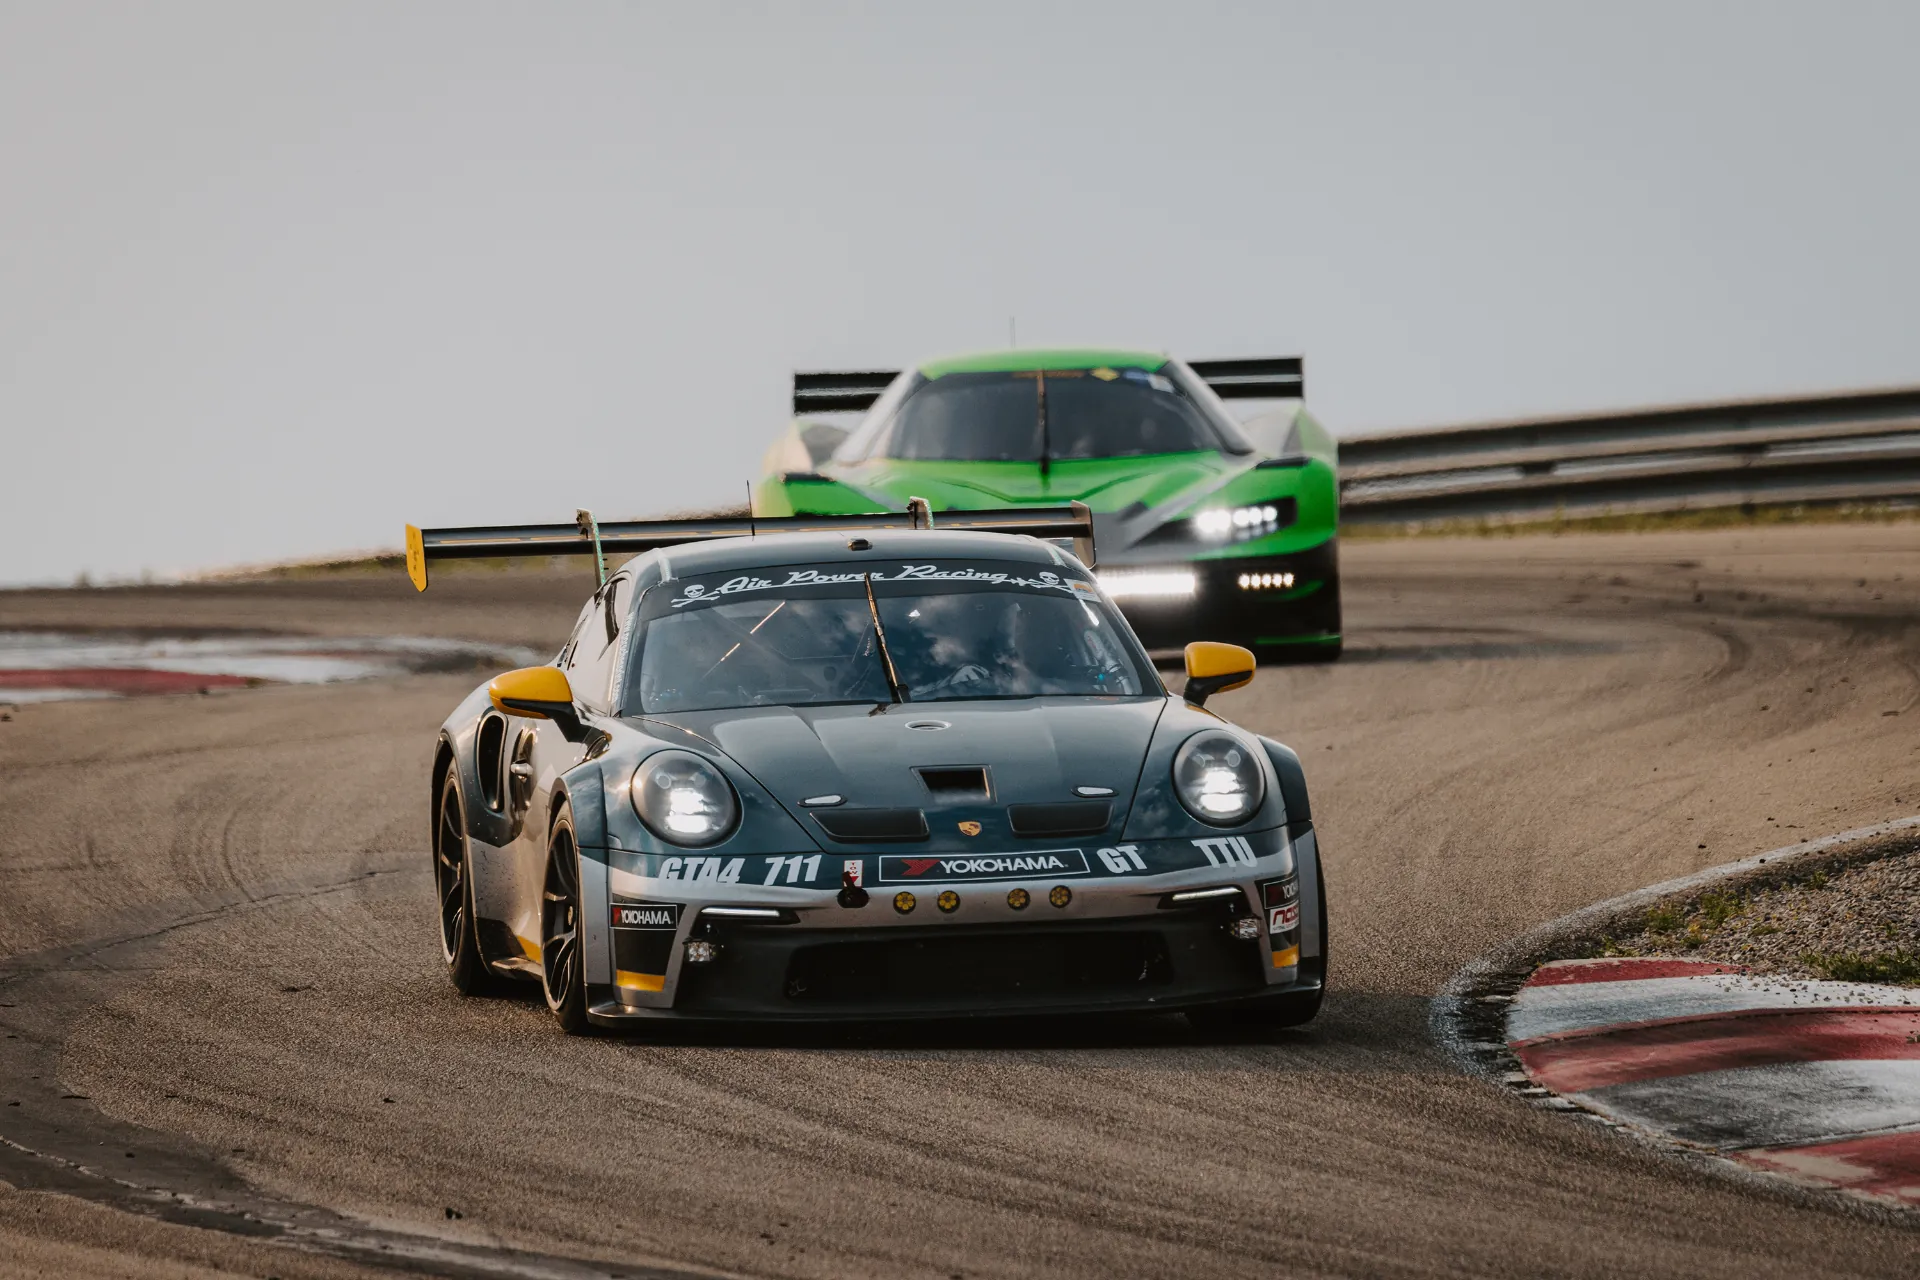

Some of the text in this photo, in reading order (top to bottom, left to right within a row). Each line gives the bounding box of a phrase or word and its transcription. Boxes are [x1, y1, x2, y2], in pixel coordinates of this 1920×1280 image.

[717, 565, 1008, 594] Air Power Racing
[939, 855, 1064, 874] YOKOHAMA
[1096, 836, 1259, 874] GT TTU
[659, 854, 822, 886] GTA4 711
[620, 909, 672, 925] YOKOHAMA
